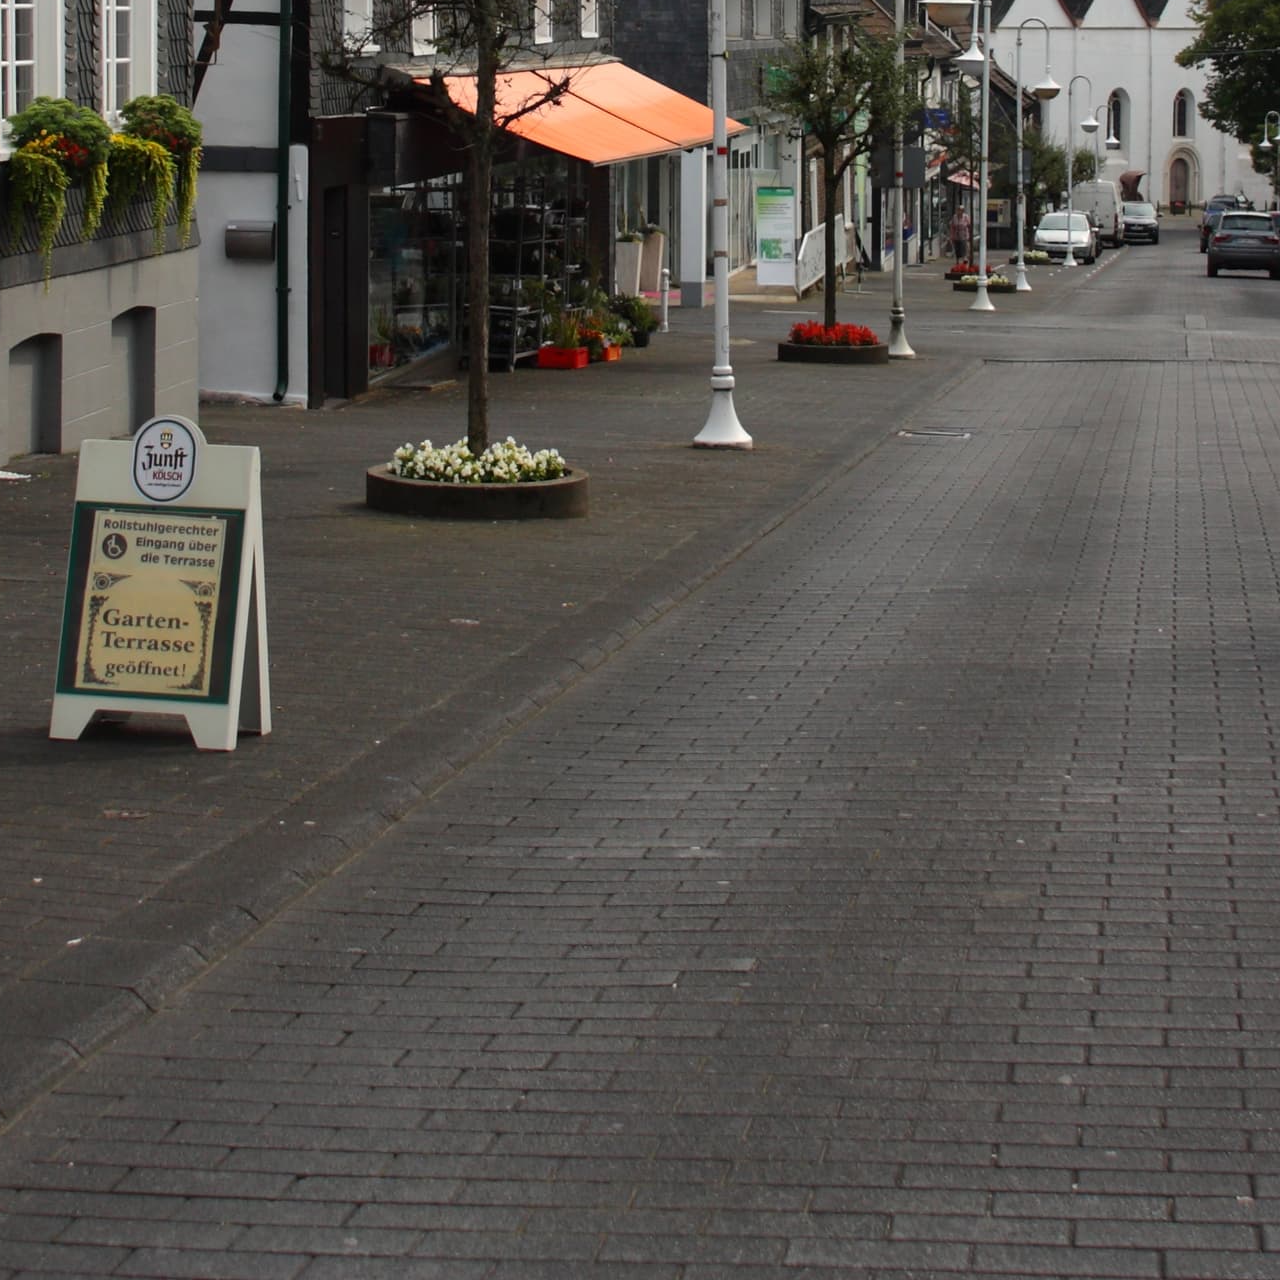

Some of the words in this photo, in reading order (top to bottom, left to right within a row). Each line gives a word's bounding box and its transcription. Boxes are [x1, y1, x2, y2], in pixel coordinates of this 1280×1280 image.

[152, 469, 183, 481] KÖLSCH
[103, 519, 219, 537] Rollstuhlgerechter
[136, 536, 185, 551] Eingang
[189, 539, 218, 552] über
[140, 552, 160, 564] die
[164, 554, 216, 568] Terrasse
[102, 608, 190, 630] Garten-
[101, 630, 195, 653] Terrasse
[104, 660, 186, 678] geöffnet!
